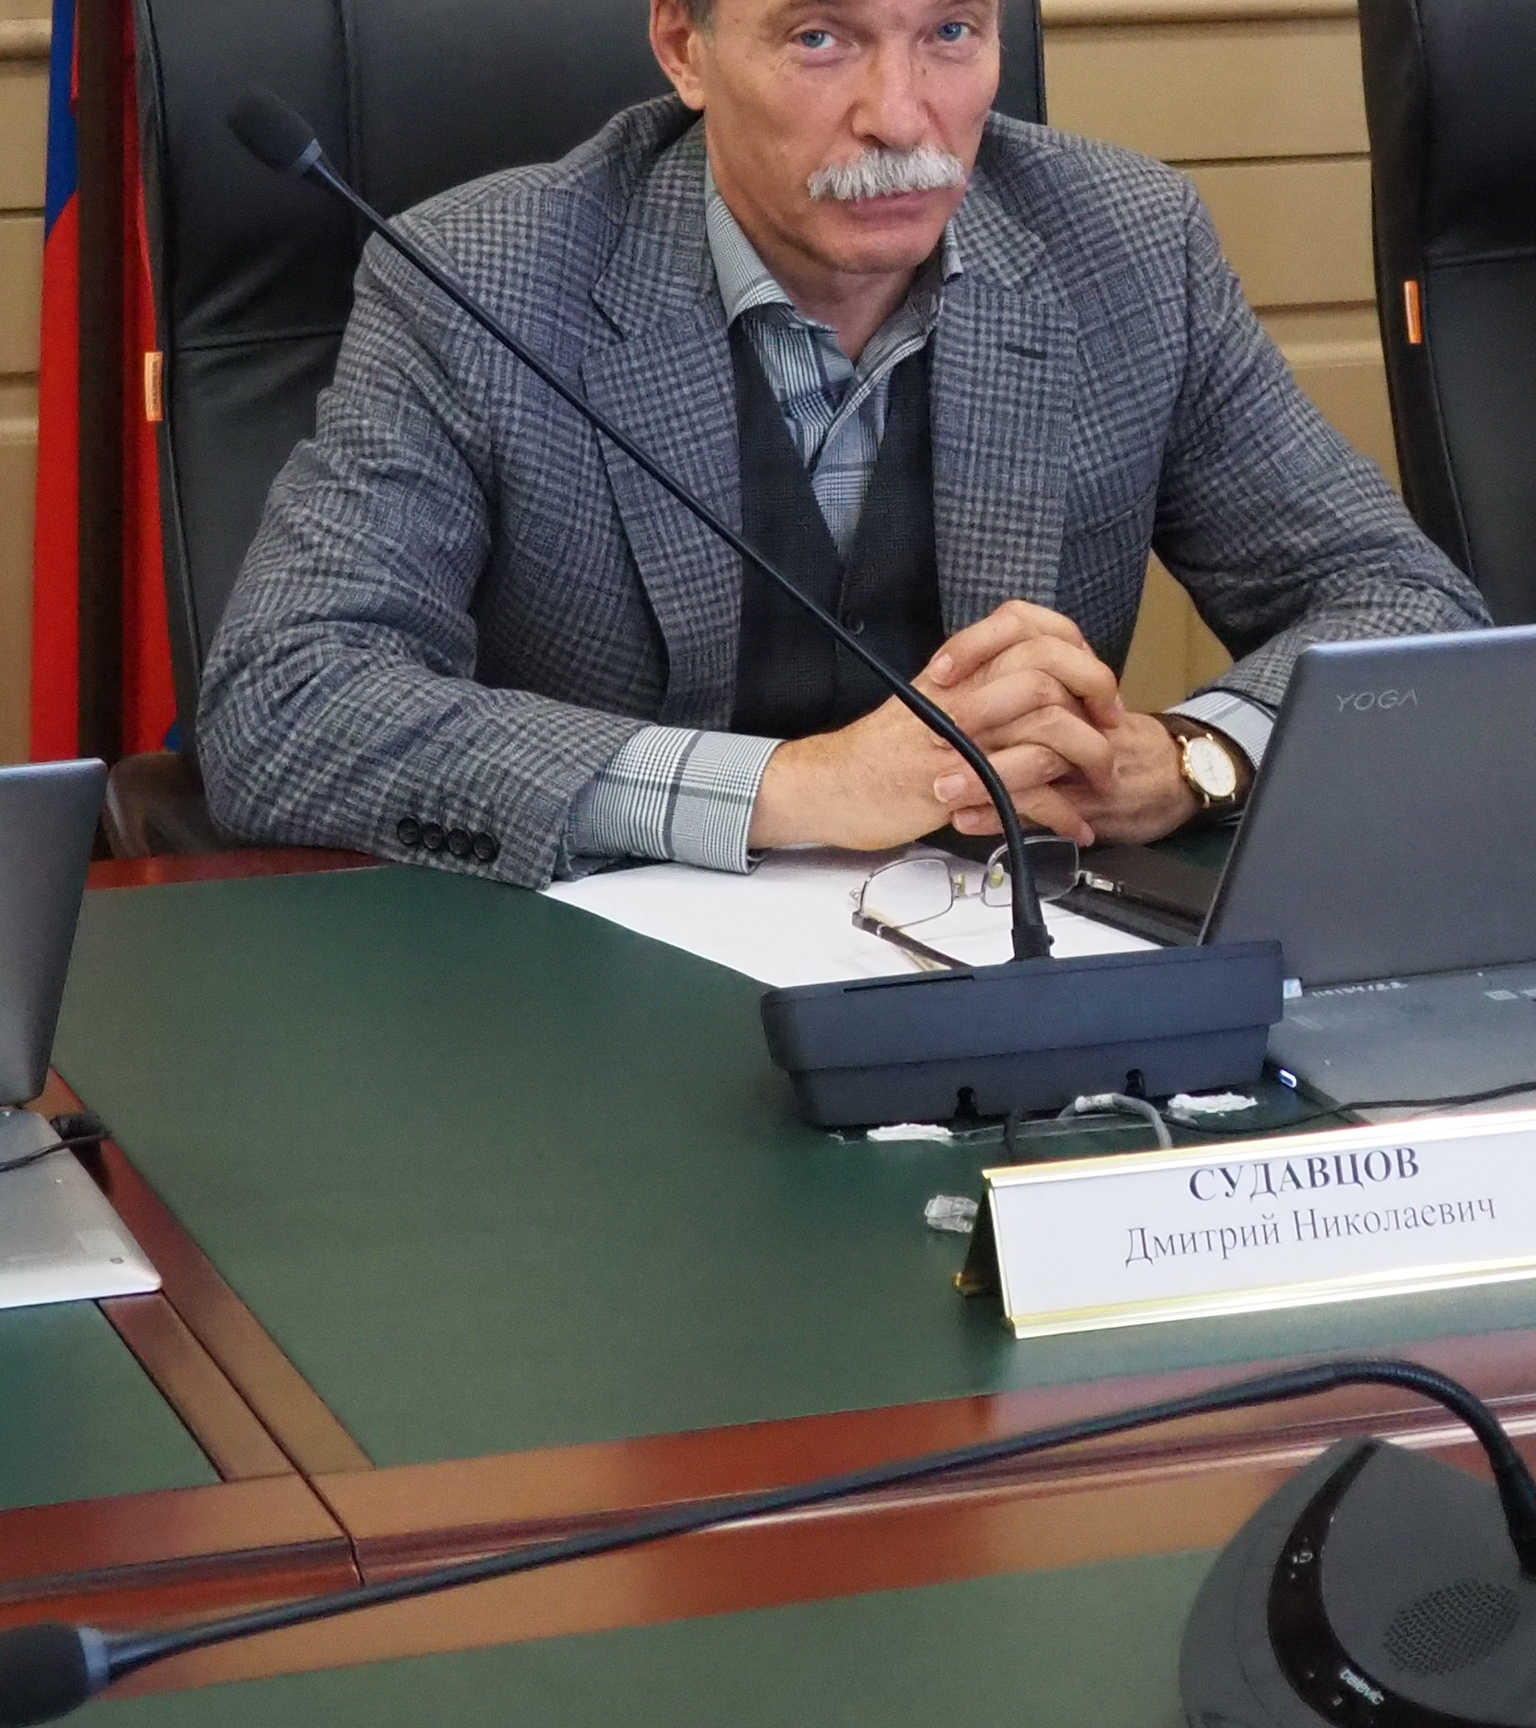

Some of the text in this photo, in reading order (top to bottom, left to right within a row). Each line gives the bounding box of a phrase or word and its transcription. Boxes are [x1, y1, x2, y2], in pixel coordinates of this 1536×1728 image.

[1335, 689, 1418, 712] YOGA
[1188, 1146, 1420, 1202] СУДАВЦОВ
[1124, 1197, 1497, 1268] Дмитрий Николаевич
